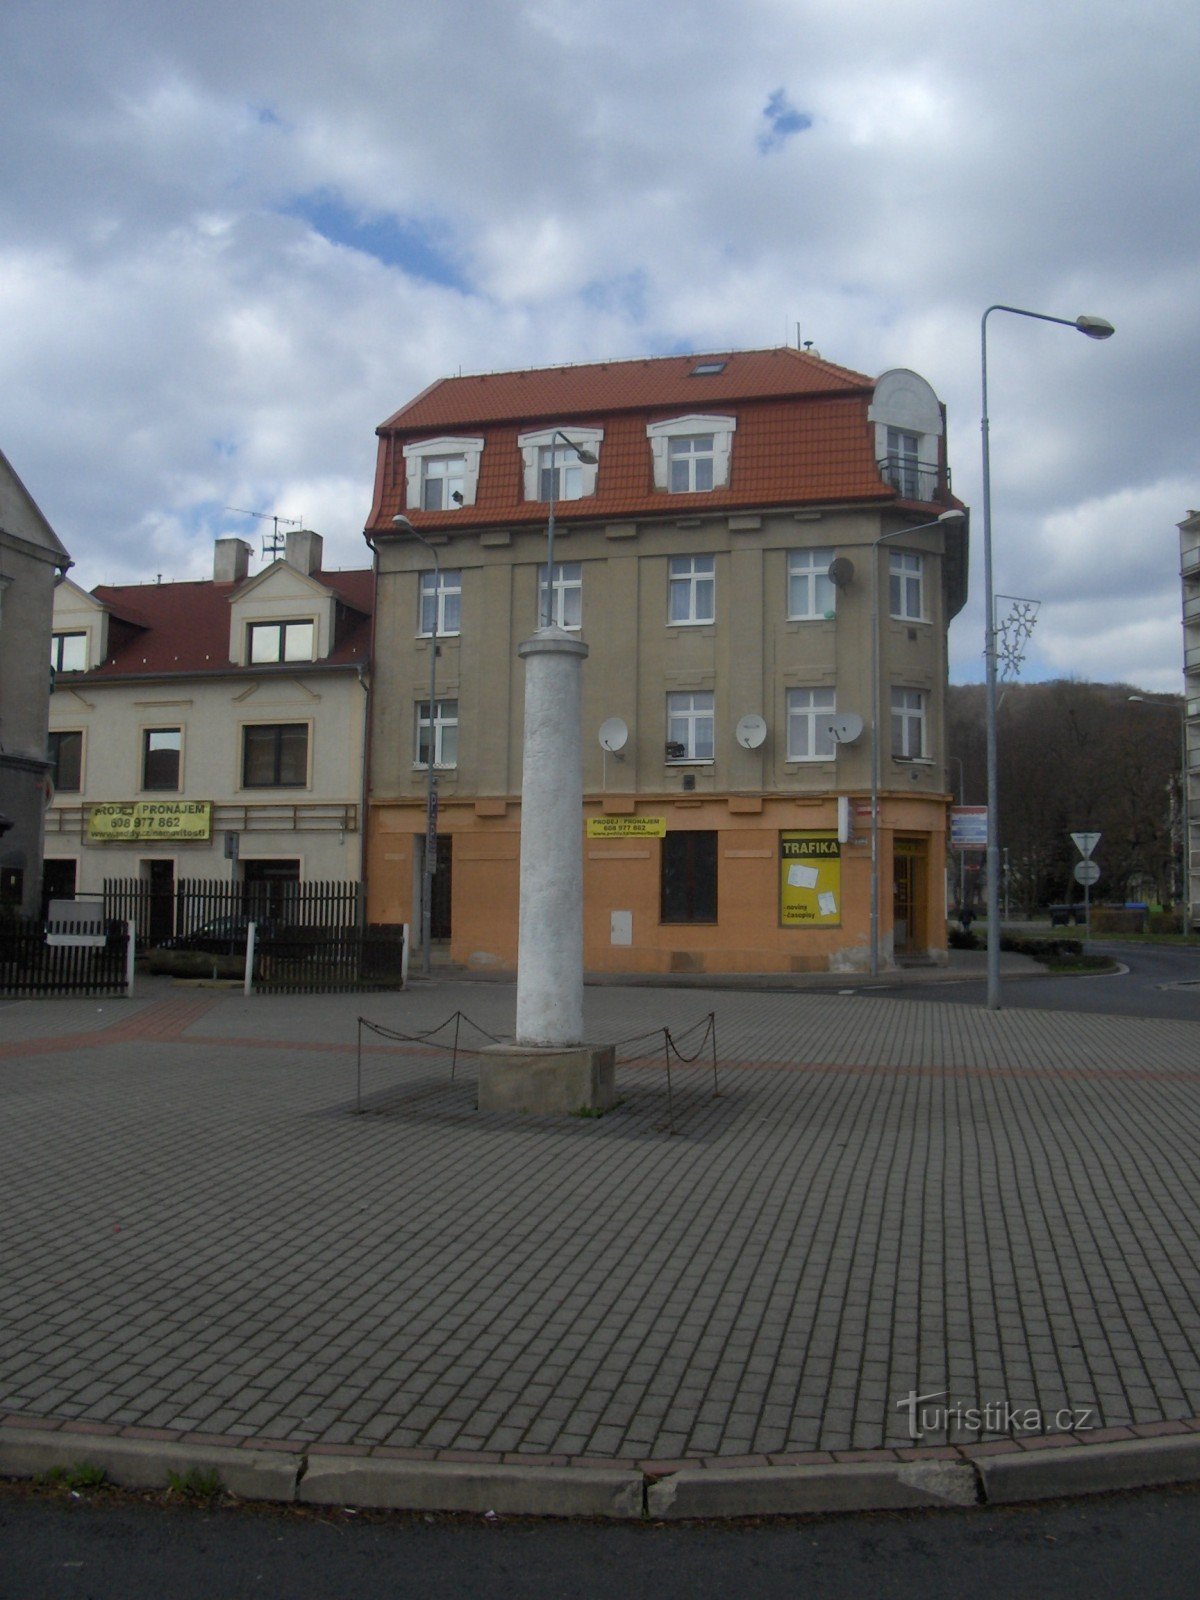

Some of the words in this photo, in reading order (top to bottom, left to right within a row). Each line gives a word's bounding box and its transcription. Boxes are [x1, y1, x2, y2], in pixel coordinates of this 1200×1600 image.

[95, 805, 134, 816] PRODEJ
[142, 804, 205, 814] PRONÁJEM
[111, 818, 131, 828] 608
[134, 818, 154, 828] 977
[158, 817, 180, 827] 862
[783, 842, 838, 854] TRAFIKA
